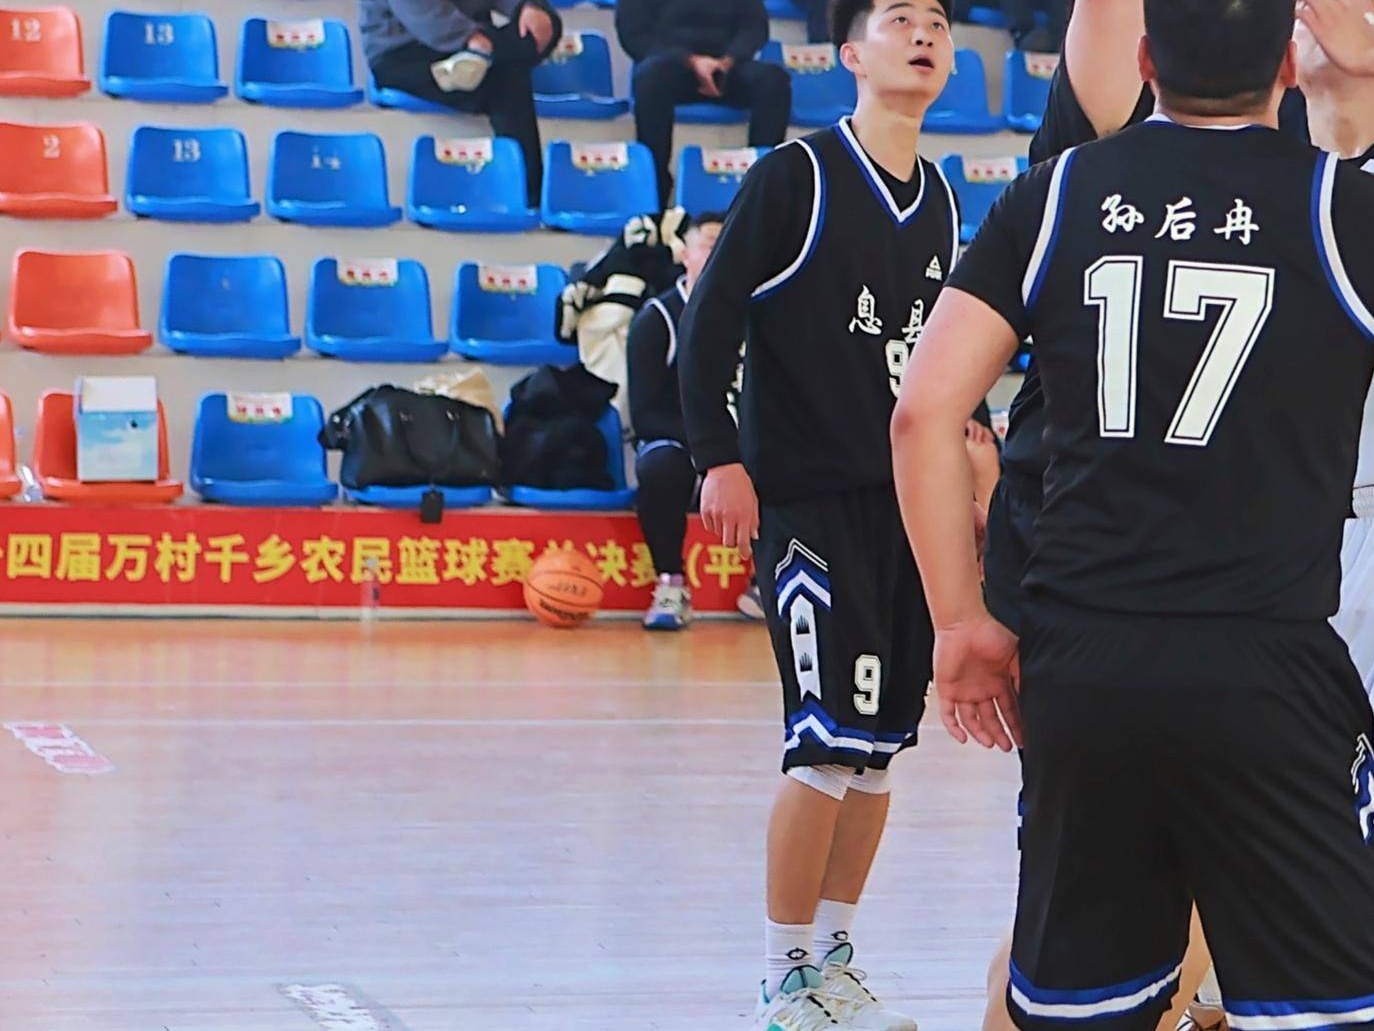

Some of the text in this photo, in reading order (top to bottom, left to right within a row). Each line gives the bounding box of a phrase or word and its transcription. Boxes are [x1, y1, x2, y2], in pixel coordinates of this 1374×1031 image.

[10, 19, 42, 43] 12
[144, 22, 174, 46] 13
[42, 136, 60, 159] 2
[172, 138, 201, 163] 13
[1100, 193, 1260, 245] 孙后冉
[1084, 255, 1276, 447] 17
[0, 532, 747, 590] 四届万村千乡农民篮球赛决赛（平
[853, 653, 881, 716] 9
